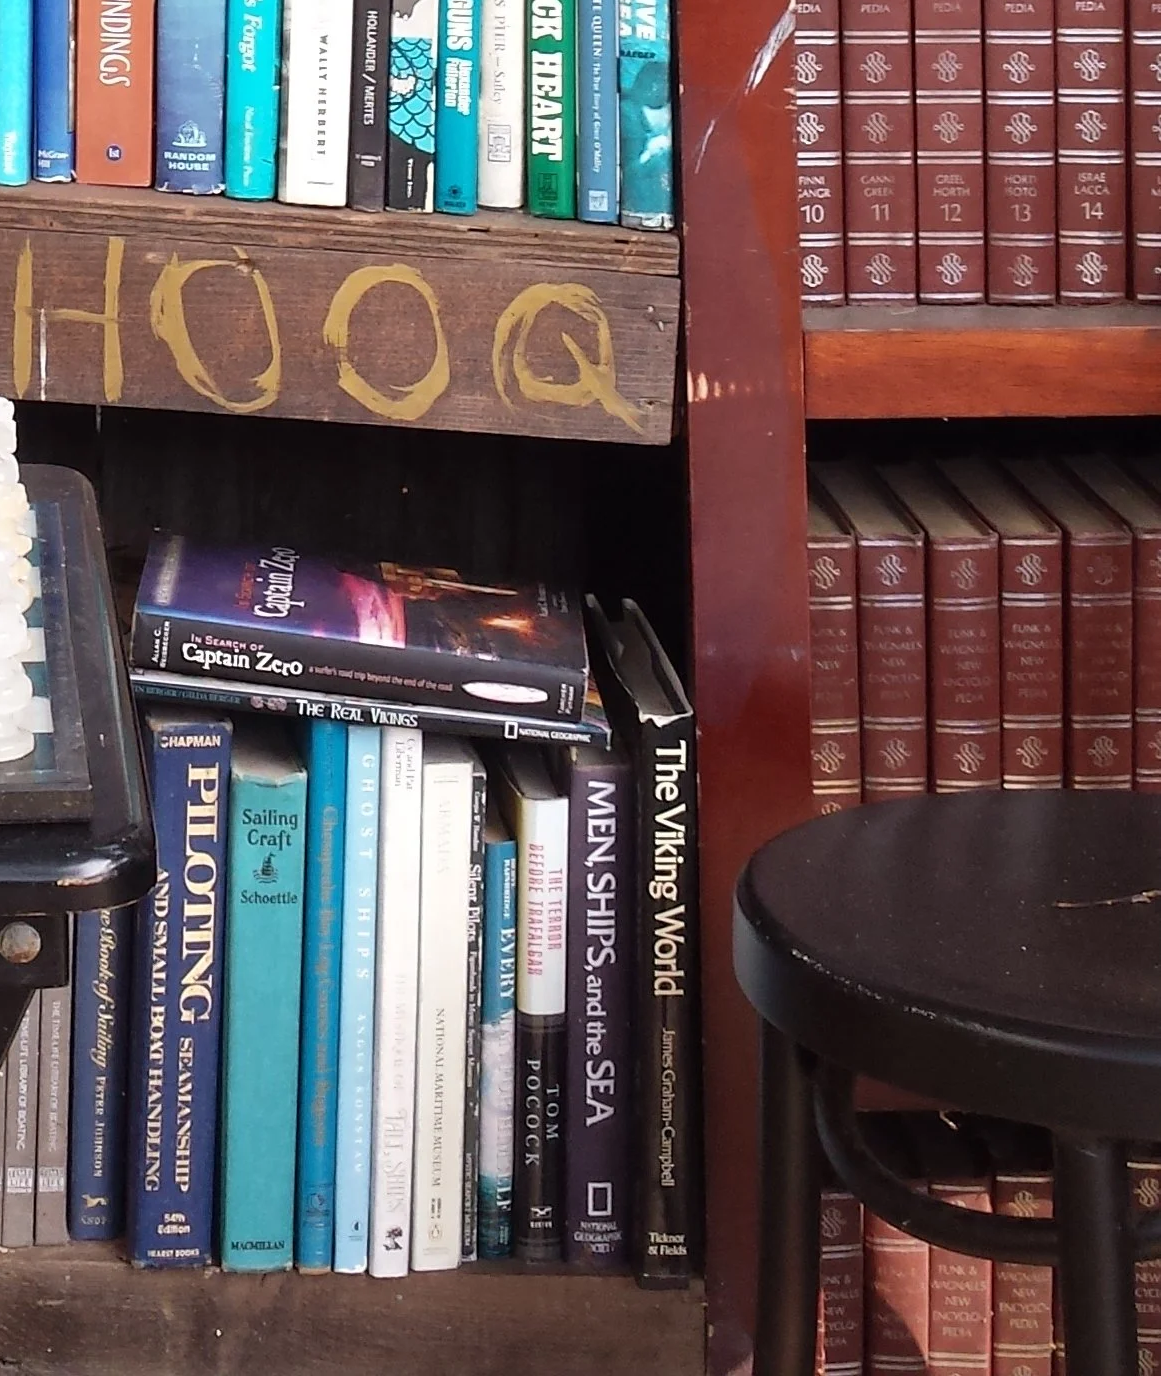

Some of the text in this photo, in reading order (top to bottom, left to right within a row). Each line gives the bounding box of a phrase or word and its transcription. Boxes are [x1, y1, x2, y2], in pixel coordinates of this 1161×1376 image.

[239, 13, 263, 71] Forgot
[532, 51, 563, 161] HEART
[165, 152, 215, 161] RANDOM
[169, 162, 209, 172] HOUSE
[1078, 173, 1106, 184] ISRAE
[1075, 185, 1110, 196] LACCA
[800, 204, 824, 223] 10
[941, 204, 962, 222] 12
[1081, 202, 1104, 220] 14
[182, 643, 302, 676] Captain Zero
[297, 699, 418, 727] THE REAL VIKINGS
[519, 727, 590, 742] NATIONAL GEOGRAPHIC
[242, 809, 298, 829] Sailing
[247, 829, 293, 847] Craft
[648, 740, 686, 997] The Viking World
[179, 762, 218, 1023] PILOTING
[240, 890, 298, 903] Schoettle
[585, 781, 616, 1126] MEN, SHIPS, and the SEA
[175, 1037, 194, 1192] SEAMANSHIP
[525, 1058, 541, 1166] POCOCK
